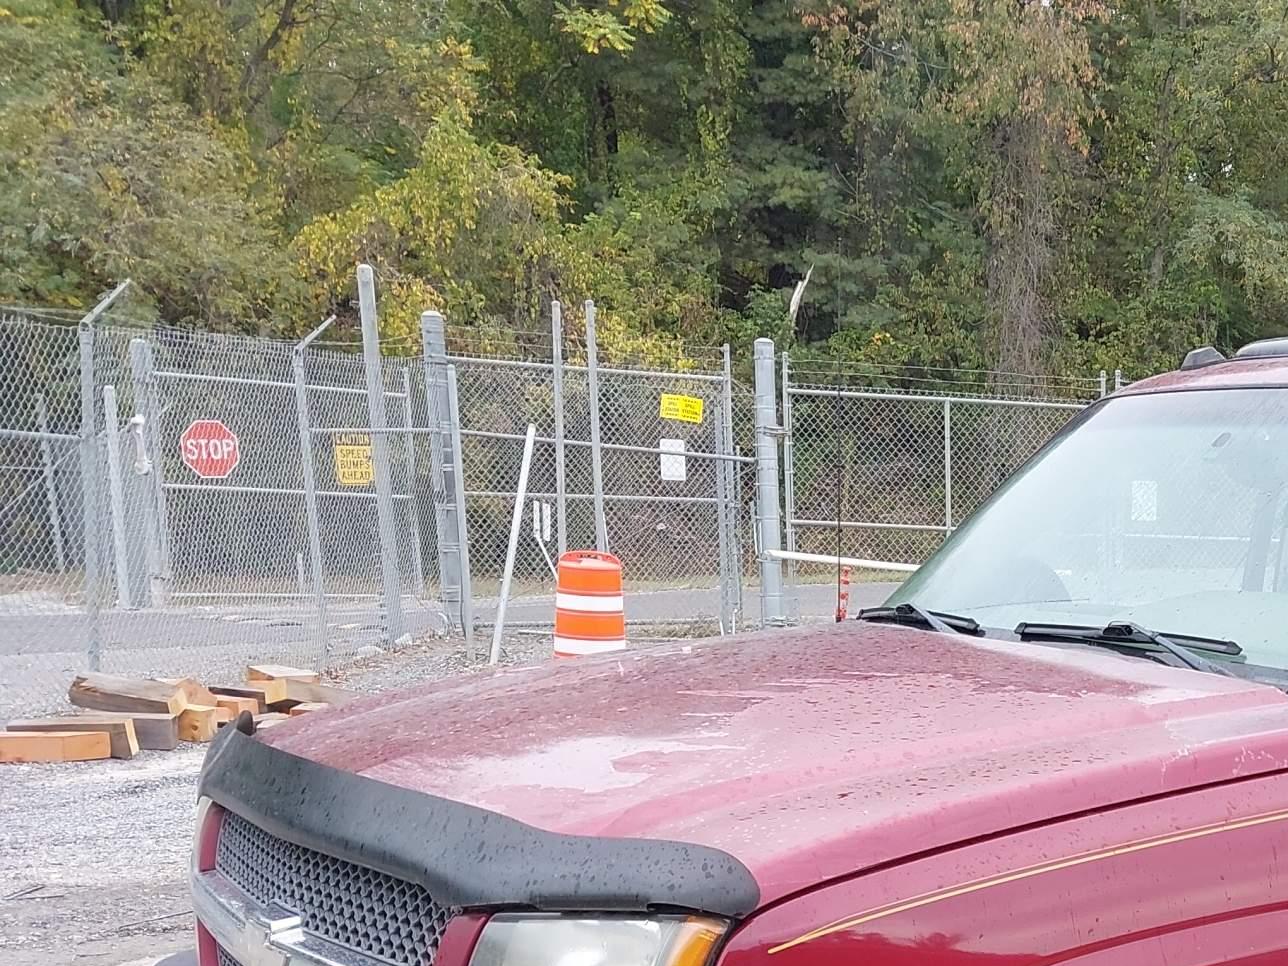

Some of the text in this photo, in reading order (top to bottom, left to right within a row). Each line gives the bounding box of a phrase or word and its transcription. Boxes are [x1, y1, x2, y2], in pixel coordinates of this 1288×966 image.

[186, 438, 235, 460] STOP
[340, 448, 369, 459] SPEED
[340, 459, 370, 470] BUMPS
[341, 470, 371, 481] AHEAD
